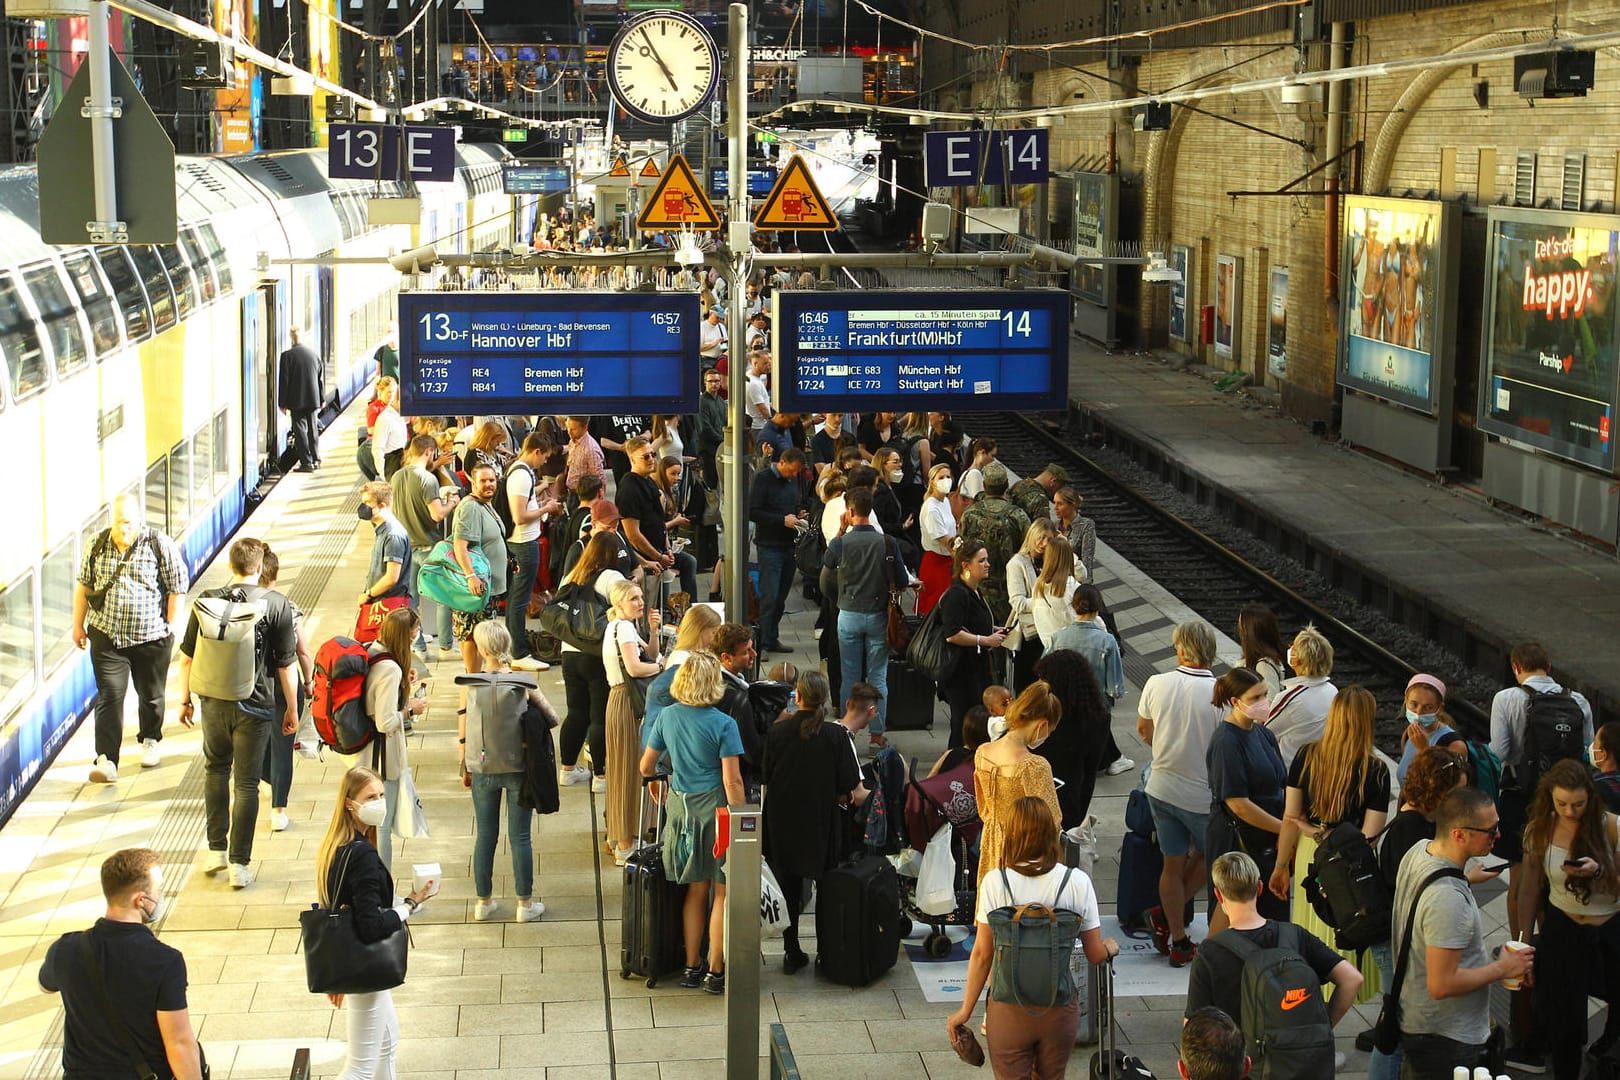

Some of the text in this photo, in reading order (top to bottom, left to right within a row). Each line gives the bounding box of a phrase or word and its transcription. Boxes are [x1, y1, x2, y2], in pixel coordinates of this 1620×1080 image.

[547, 128, 560, 140] 13
[336, 129, 378, 168] 13
[408, 132, 432, 172] E
[1000, 134, 1041, 171] 14
[946, 136, 972, 177] E
[1535, 236, 1558, 258] Let's
[1523, 266, 1593, 316] happy.
[650, 313, 680, 325] 16:57
[799, 312, 829, 324] 16:46
[419, 313, 468, 340] 13 D-F
[500, 323, 510, 331] (L)
[517, 322, 551, 332] Lüneburg
[1003, 311, 1032, 338] 14
[472, 333, 572, 348] Hannover Hbf
[848, 331, 962, 346] Frankfurt(M)Hbf
[1539, 351, 1563, 374] Parship
[420, 368, 448, 378] 17:15
[472, 368, 489, 377] RE4
[524, 368, 584, 378] Bremen Hbf
[798, 366, 824, 376] 17:01
[848, 366, 880, 375] ICE 683
[899, 365, 962, 375] München Hbf
[420, 382, 448, 392] 17:37
[472, 383, 496, 392] RB41
[524, 382, 584, 392] Bremen Hbf
[798, 381, 825, 390] 17:24
[848, 380, 880, 389] ICE 773
[898, 379, 942, 391] Stuttgart
[947, 379, 964, 389] Hbf
[1286, 988, 1306, 1001] NIKE
